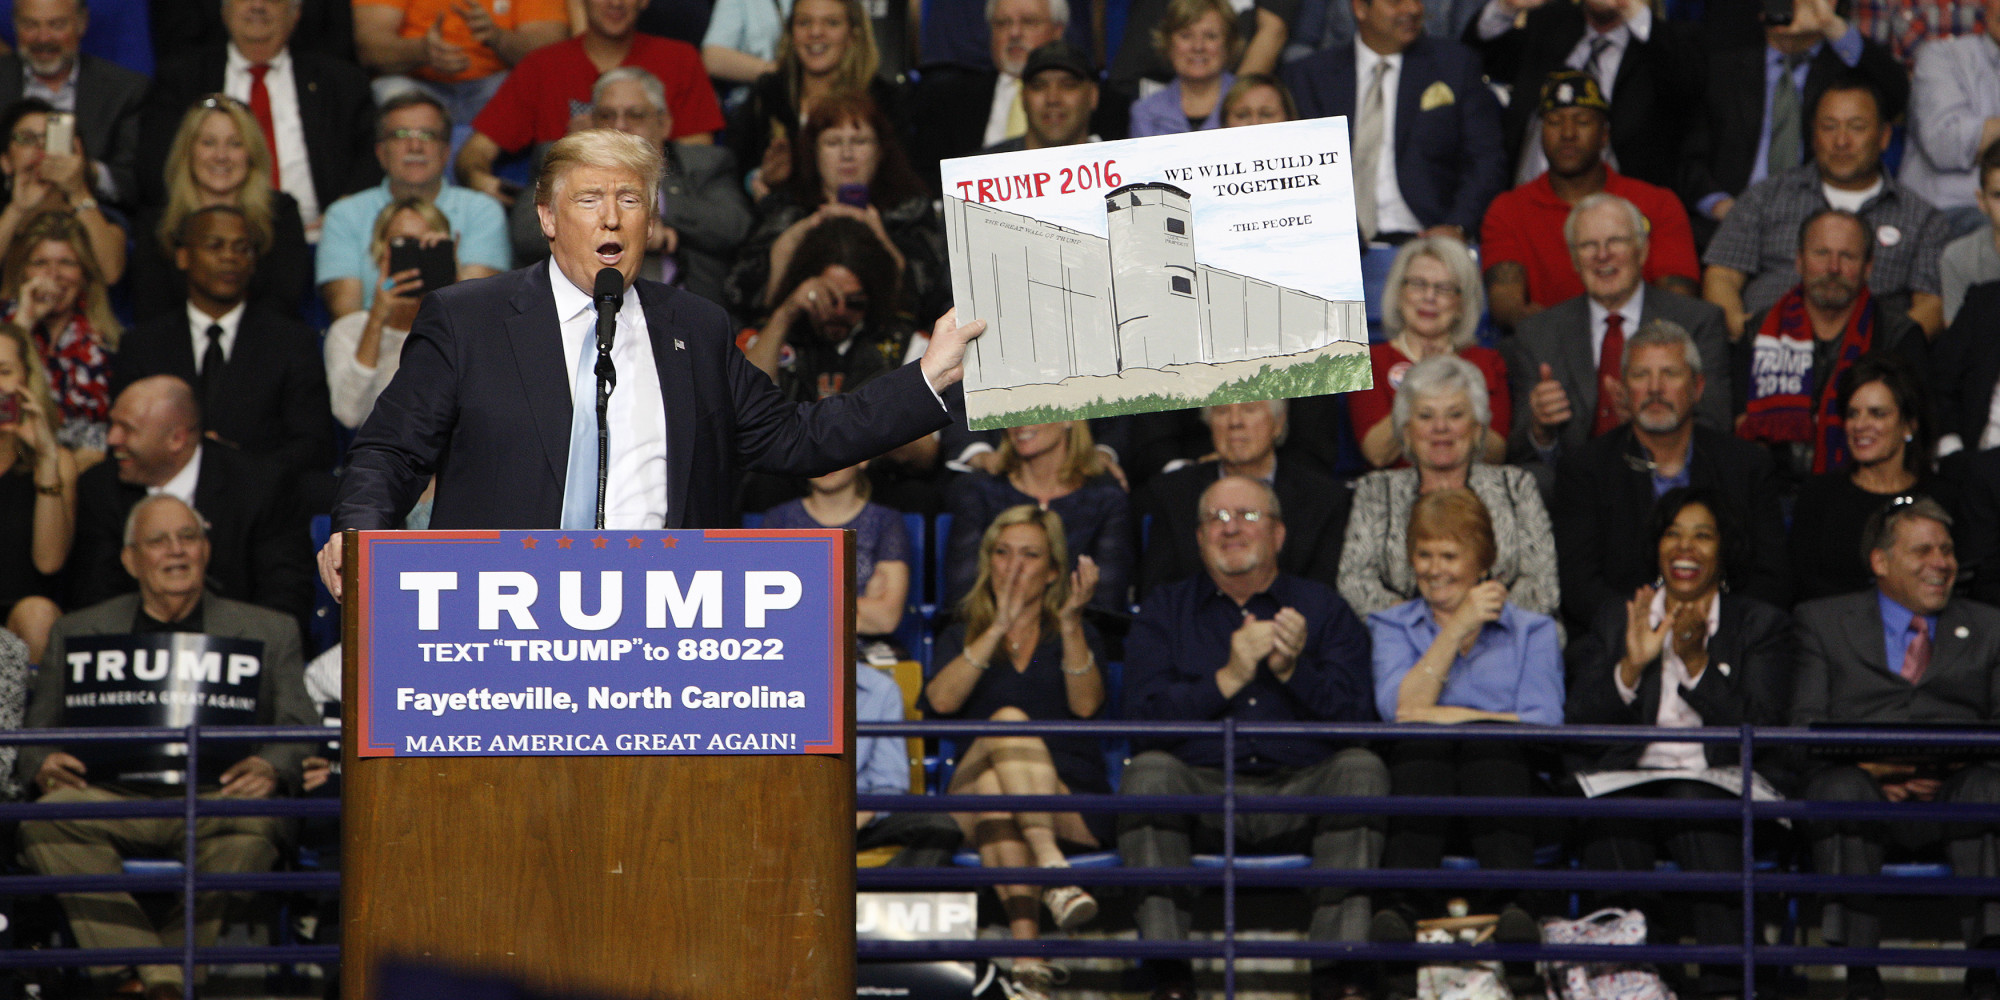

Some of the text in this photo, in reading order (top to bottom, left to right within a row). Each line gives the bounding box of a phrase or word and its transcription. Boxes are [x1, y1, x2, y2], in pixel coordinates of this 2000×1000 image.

[1164, 151, 1339, 182] WE WILL BUILD IT
[956, 159, 1121, 203] TRUMP 2016
[1213, 173, 1321, 197] TOGETHER
[984, 218, 999, 226] THE
[999, 221, 1024, 232] GREAT
[1025, 227, 1044, 237] WALL
[1045, 231, 1055, 239] OF
[1262, 214, 1313, 229] PEOPLE
[1757, 375, 1802, 398] 2016
[399, 570, 803, 631] TRUMP
[418, 642, 490, 662] TEXT
[642, 642, 670, 661] to
[677, 638, 784, 661] 88022
[66, 649, 260, 685] TRUMP
[65, 692, 96, 708] MAKE
[98, 690, 157, 706] AMERICA
[397, 685, 806, 716] Fayetteville, North Carolina
[405, 732, 797, 753] MAKE AMERICA GREAT AGAIN!
